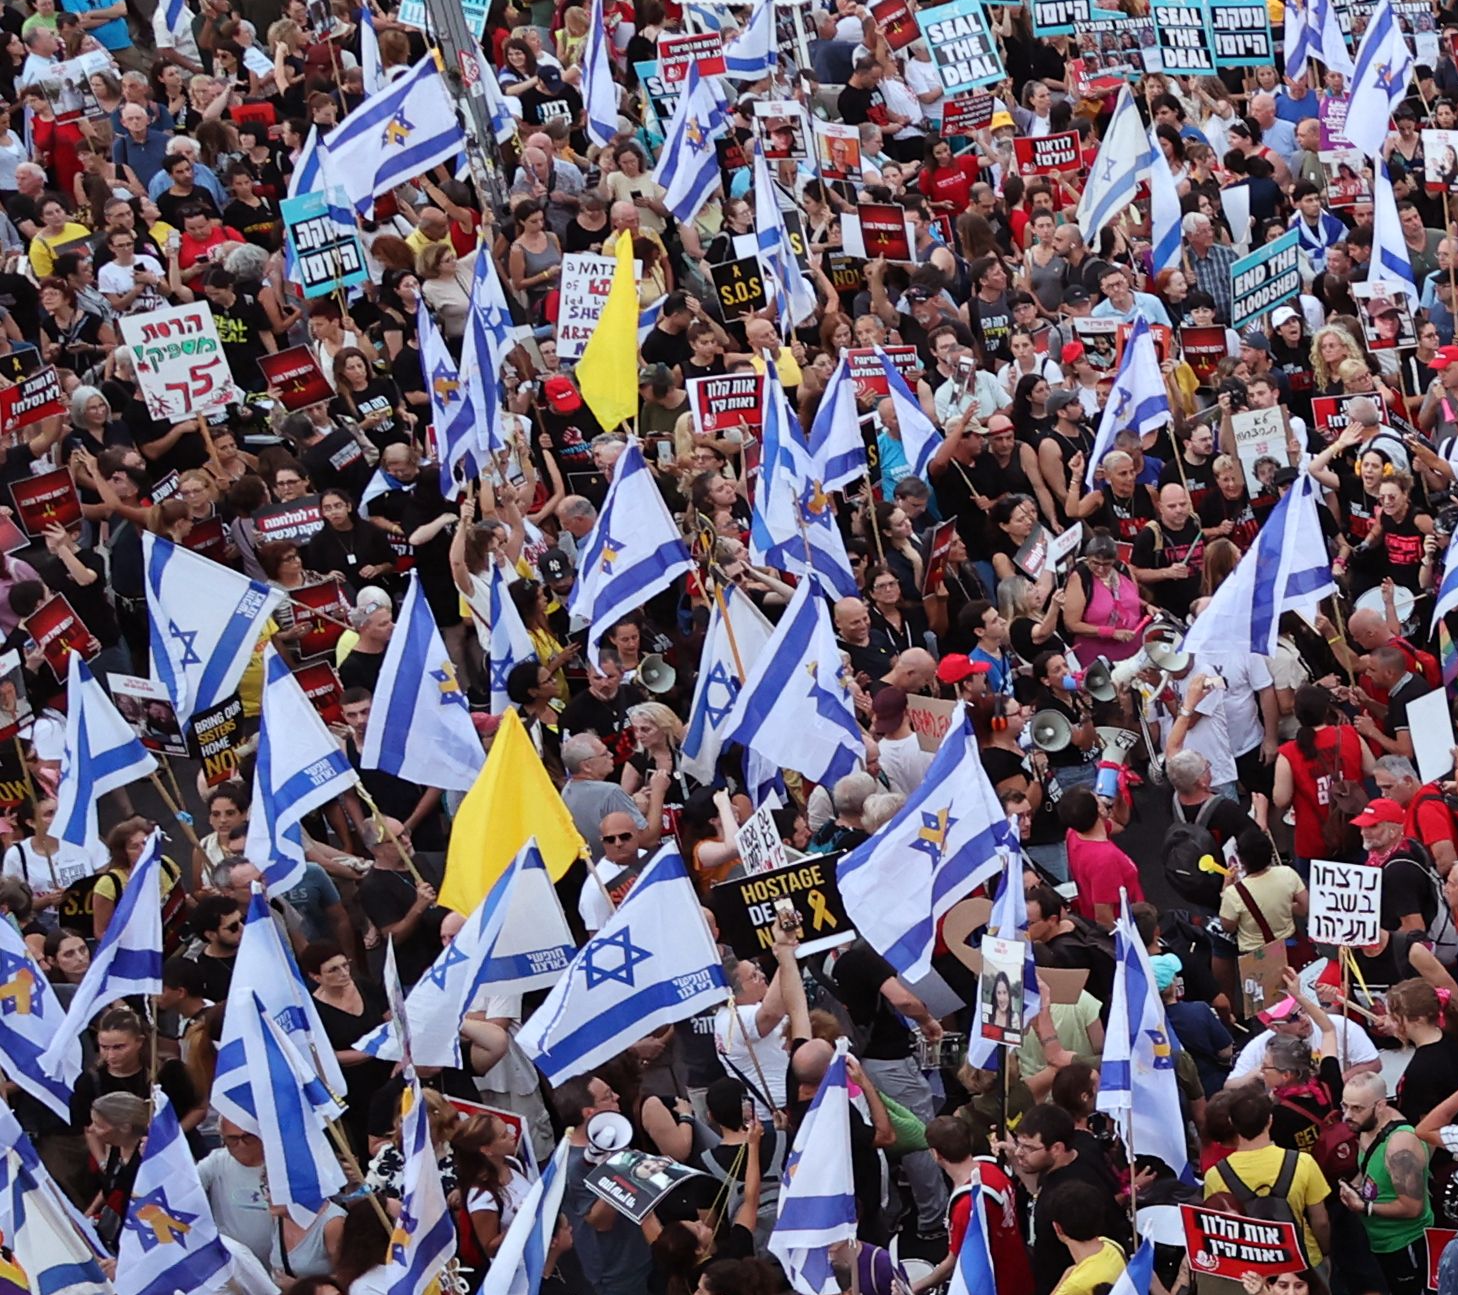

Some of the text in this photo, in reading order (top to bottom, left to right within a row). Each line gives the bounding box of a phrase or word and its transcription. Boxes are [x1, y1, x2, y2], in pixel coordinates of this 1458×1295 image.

[1036, 0, 1089, 26] היום!
[1156, 8, 1202, 27] SEAL
[932, 14, 981, 43] SEAL
[1165, 28, 1200, 47] THE
[941, 38, 984, 64] THE
[1163, 47, 1210, 69] DEAL
[1216, 34, 1267, 56] היום!
[945, 54, 996, 88] DEAL
[1234, 245, 1298, 298] END THE
[721, 278, 761, 306] S.O.S
[1233, 276, 1299, 324] BLOODSHED
[139, 313, 204, 345] הרסת
[221, 329, 247, 344] EAL
[194, 700, 241, 734] BRING OUR
[197, 721, 237, 745] SISTERS
[200, 737, 231, 757] HOME
[740, 865, 825, 906] HOSTAGE
[1313, 865, 1378, 891] נרצחו
[1320, 891, 1376, 914] בשבי
[1314, 916, 1378, 943] נתניהו
[1201, 1214, 1280, 1245] אות קלון
[1209, 1239, 1284, 1263] ואות קין
